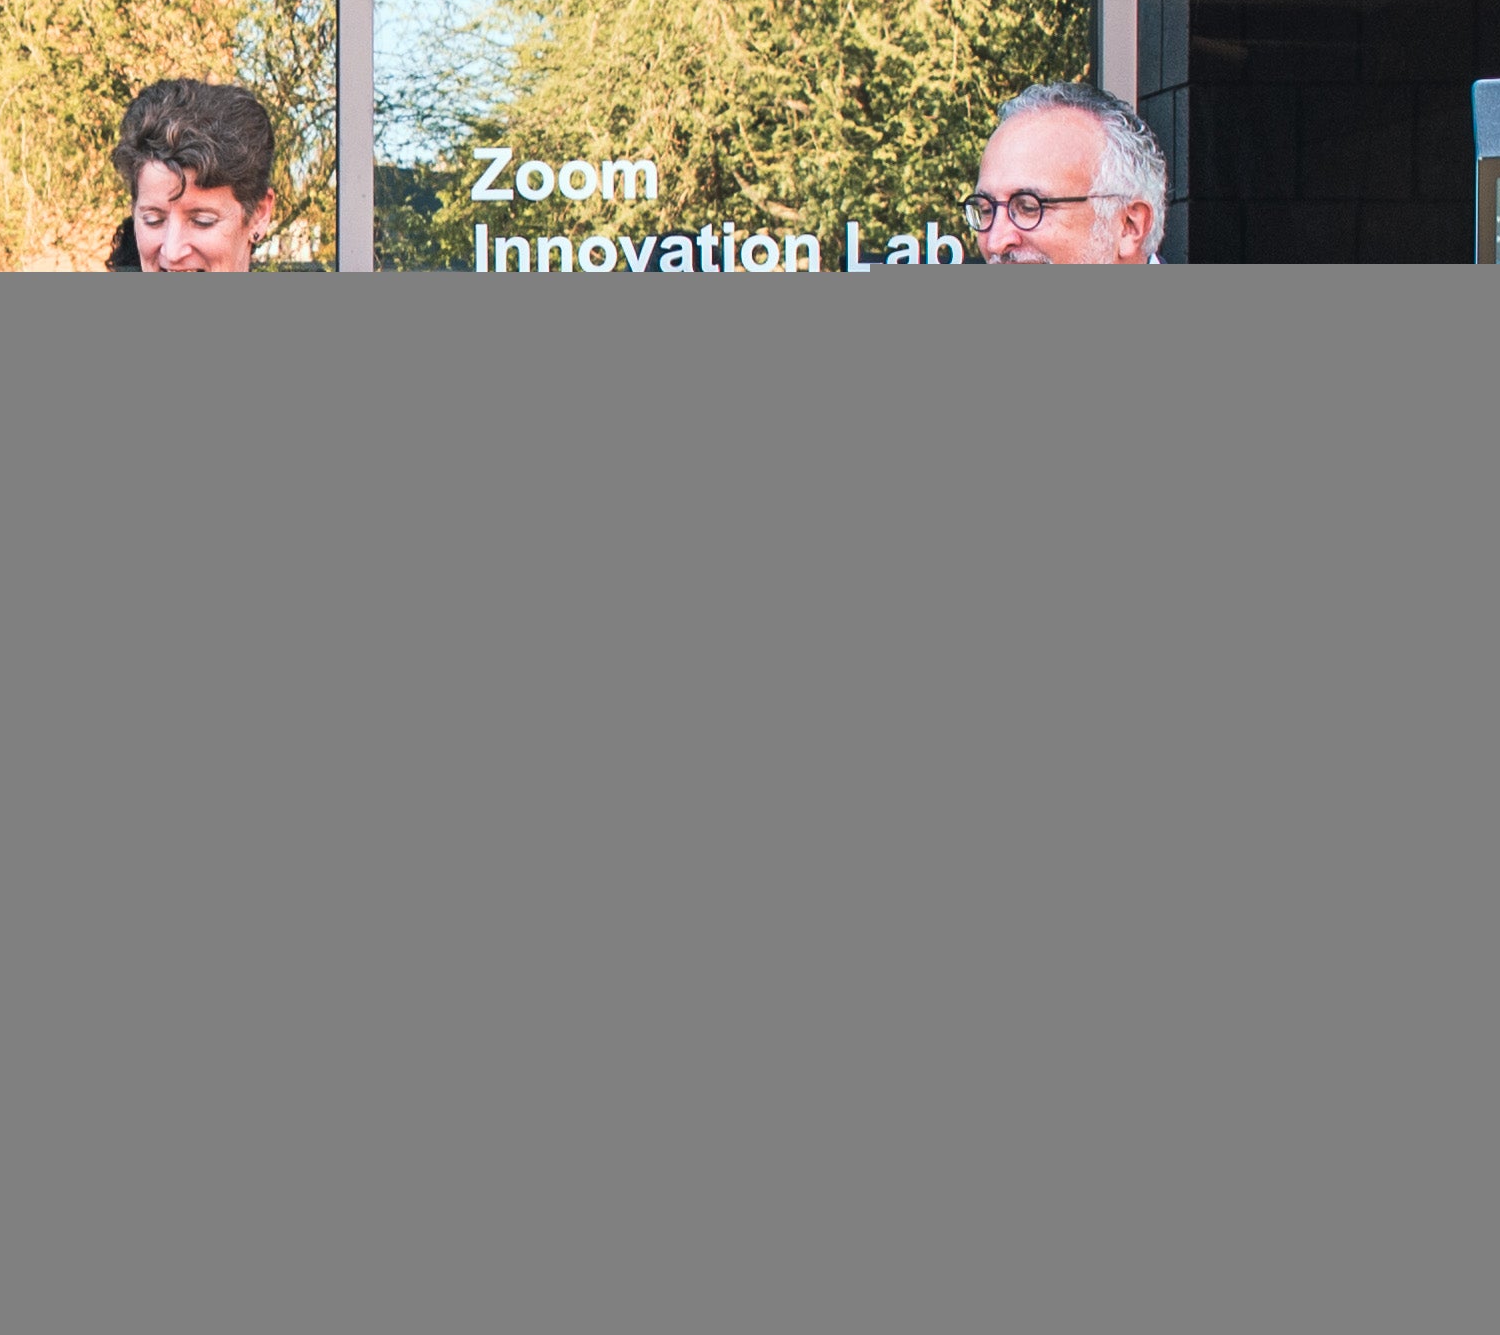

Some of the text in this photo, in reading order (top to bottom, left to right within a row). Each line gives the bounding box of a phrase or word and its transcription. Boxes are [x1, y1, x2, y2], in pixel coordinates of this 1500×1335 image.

[470, 147, 659, 202] Zoom
[474, 221, 964, 273] Innovation Lab
